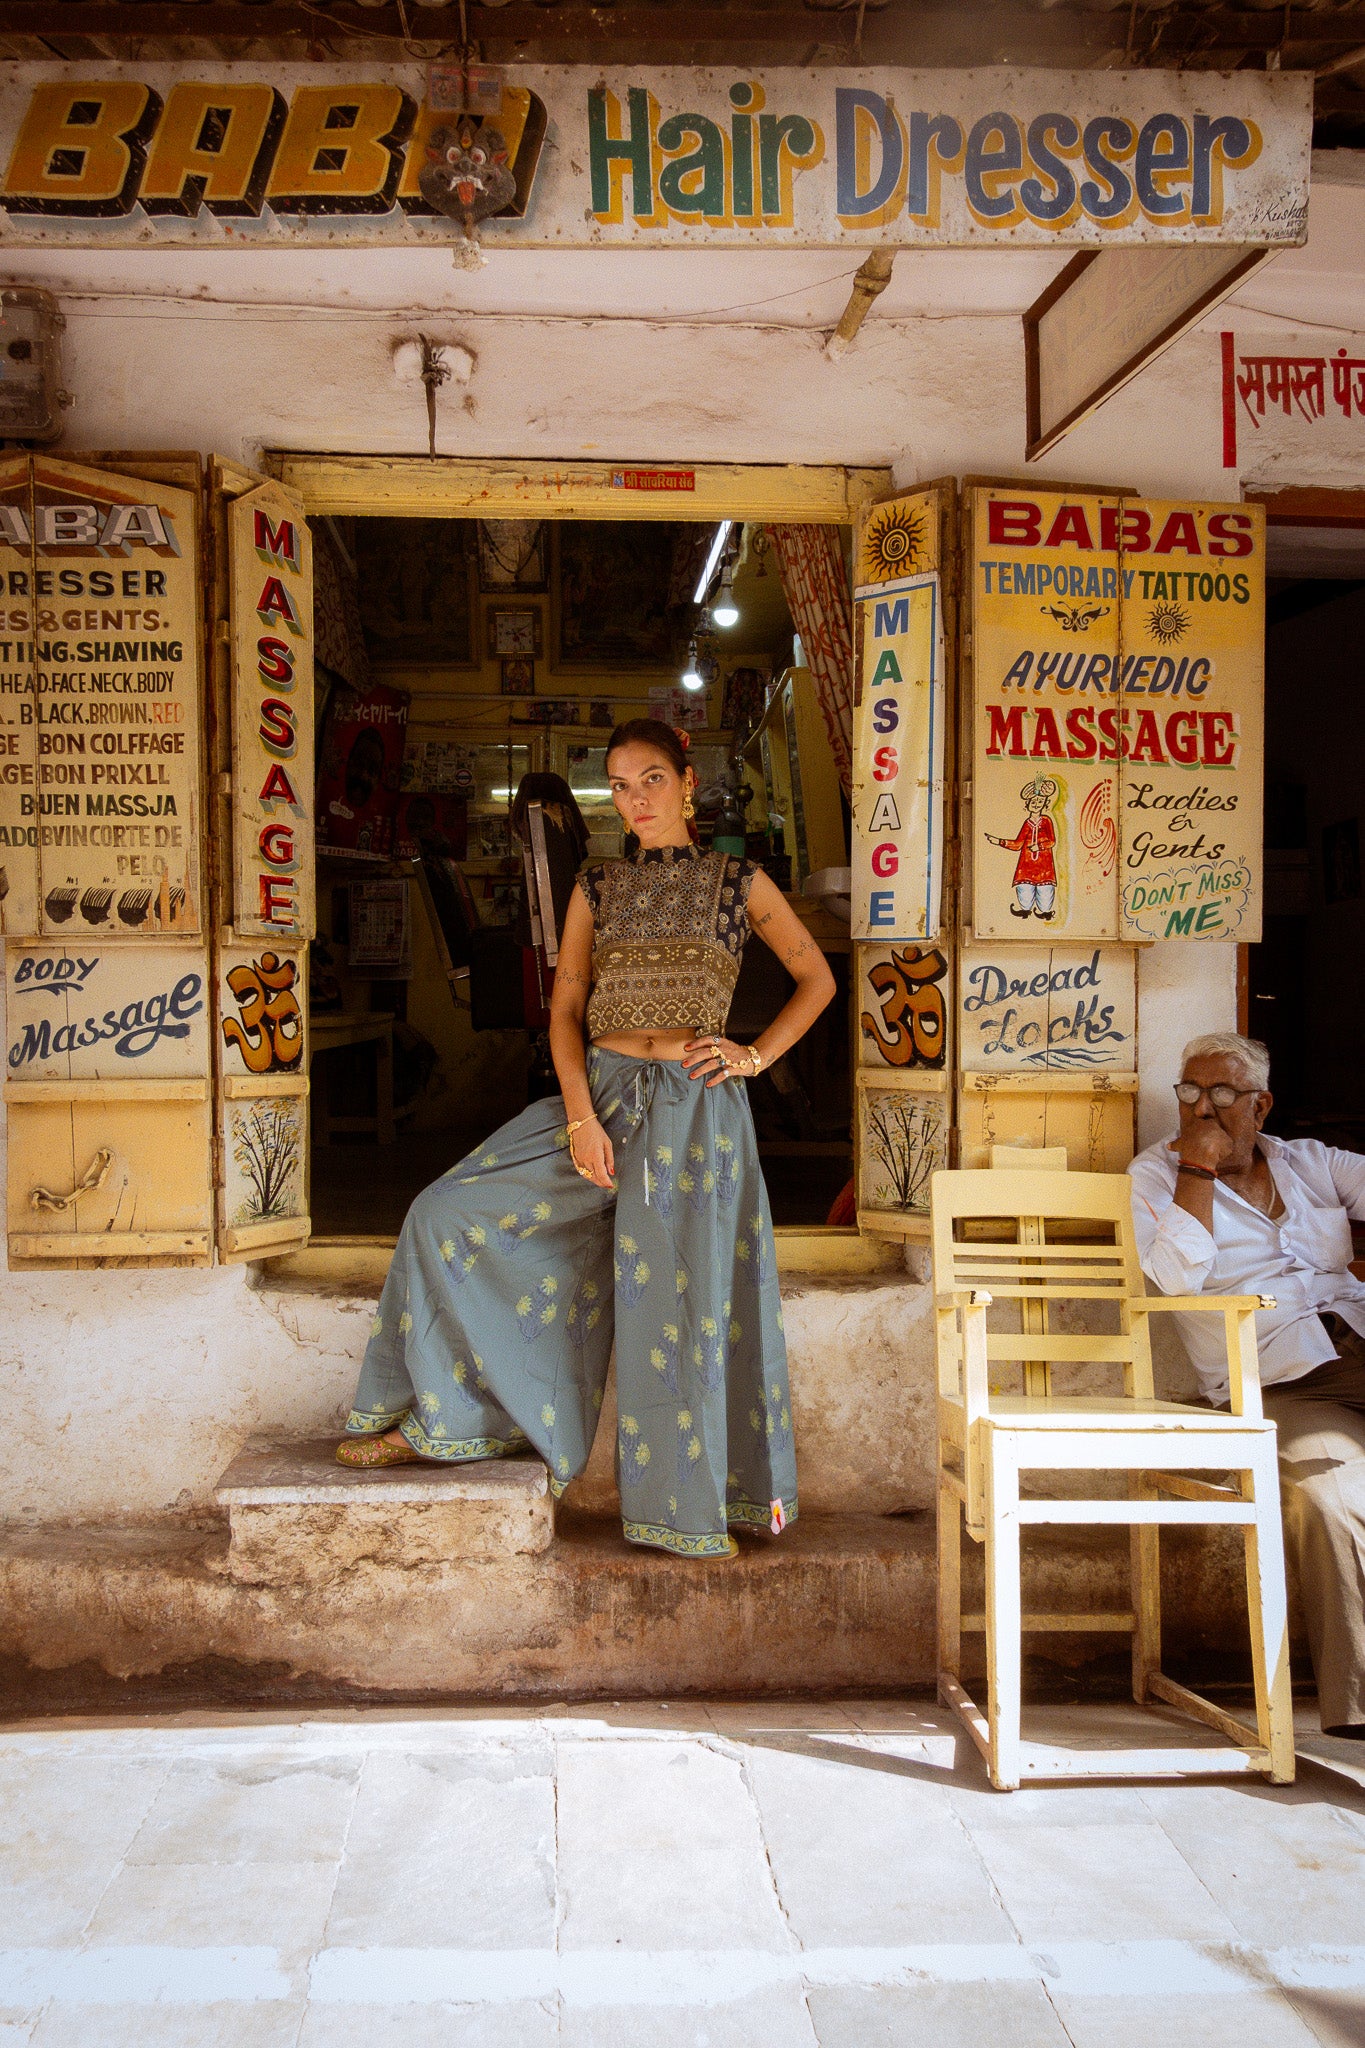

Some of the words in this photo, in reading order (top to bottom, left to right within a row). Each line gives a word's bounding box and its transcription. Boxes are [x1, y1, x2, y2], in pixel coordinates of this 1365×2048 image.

[588, 81, 824, 228] Hair
[836, 87, 1262, 230] Dresser
[1236, 356, 1327, 429] समस्त
[987, 500, 1254, 558] BABA'S
[0, 569, 167, 598] RESSER
[979, 561, 1136, 599] TEMPORARY
[1138, 571, 1250, 604] TATTOOS
[1001, 650, 1212, 698] AYURVEDIC
[254, 508, 302, 931] MASSAGE
[985, 704, 1238, 769] MASSAGE
[39, 733, 86, 755] BON
[90, 733, 185, 754] COLFFAGE
[869, 598, 910, 927] MASSAGE
[41, 764, 86, 785] BON
[91, 764, 170, 785] PRIXLL
[20, 793, 80, 815] BUEN
[86, 794, 178, 816] MASSJA
[1127, 782, 1239, 811] Ladies
[154, 825, 183, 847] DE
[1168, 812, 1200, 832] &
[117, 854, 165, 876] PELO
[1127, 831, 1226, 868] Gents
[1130, 878, 1193, 911] DON'T
[1198, 870, 1243, 897] MISS
[14, 957, 99, 984] BODY
[964, 950, 1101, 1012] Dread
[8, 973, 203, 1068] Massage
[980, 995, 1130, 1056] Locks
